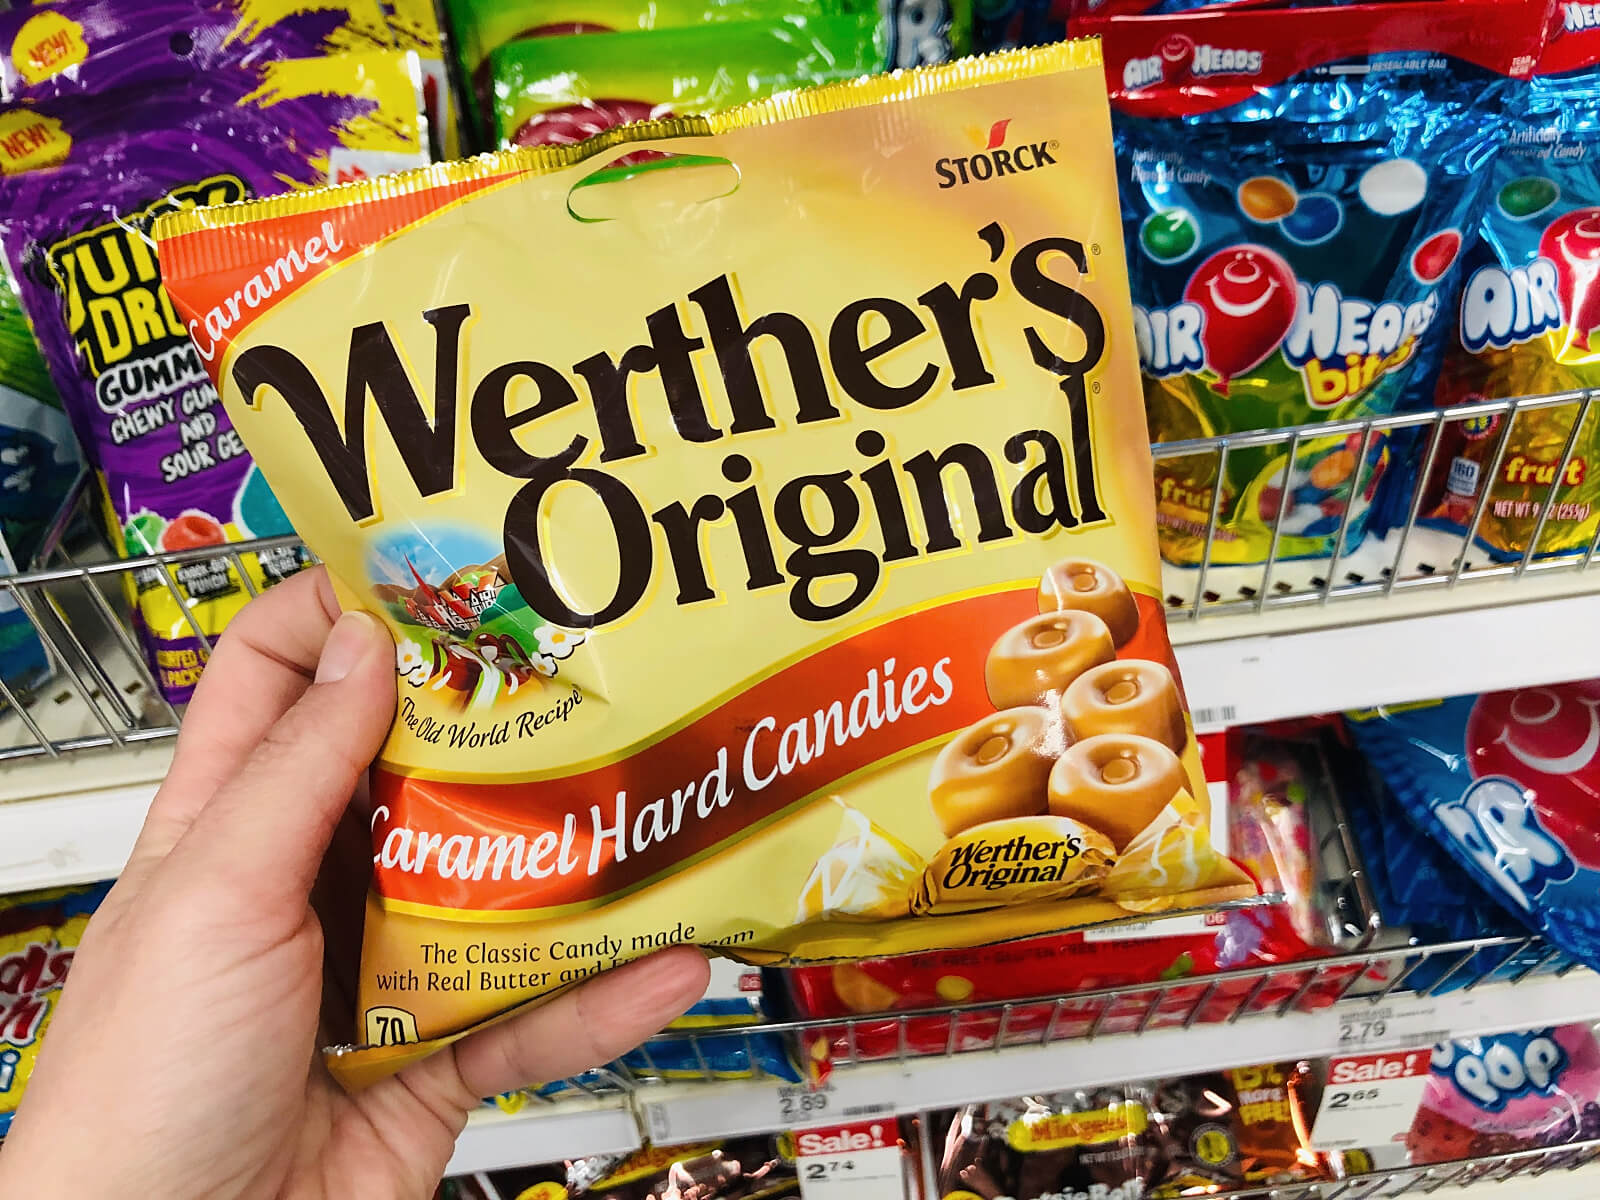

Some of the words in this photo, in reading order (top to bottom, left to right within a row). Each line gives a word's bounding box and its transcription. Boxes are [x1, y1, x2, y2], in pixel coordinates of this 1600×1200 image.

[29, 29, 75, 70] NEW!
[1123, 55, 1163, 89] AIR
[1192, 45, 1262, 75] HEADS
[1428, 58, 1447, 70] BAG
[0, 122, 56, 160] NEW!
[1554, 141, 1587, 161] Candy
[935, 141, 1057, 189] STORCK
[187, 221, 344, 362] Caramel
[1464, 261, 1562, 348] AIR
[98, 346, 204, 409] GUMM
[233, 220, 1106, 523] Werther's
[111, 398, 175, 444] CHEWY
[181, 412, 216, 445] AND
[162, 441, 216, 482] SOUR
[217, 430, 246, 460] GE
[1506, 456, 1582, 485] frut
[502, 375, 1109, 629] Original
[1494, 501, 1513, 518] NET
[1515, 501, 1530, 518] WT
[1557, 503, 1590, 521] (255g)
[401, 696, 419, 731] The
[416, 717, 445, 744] Old
[448, 721, 510, 749] World
[515, 688, 583, 739] Recipe
[371, 805, 578, 882] Caramel
[588, 746, 734, 875] Hard
[743, 657, 953, 791] Candies
[950, 834, 1081, 868] Werther's
[943, 857, 1068, 890] Original
[420, 944, 457, 965] The
[465, 941, 541, 964] Classic
[549, 934, 622, 960] Candy
[632, 922, 696, 950] made
[376, 970, 419, 992] with
[426, 969, 471, 992] Real
[480, 970, 551, 991] Butter
[376, 1016, 403, 1044] 70
[1339, 1020, 1386, 1041] 2.79
[1332, 1054, 1417, 1084] Sale!
[779, 1093, 828, 1114] 2.89
[799, 1124, 884, 1154] Sale!
